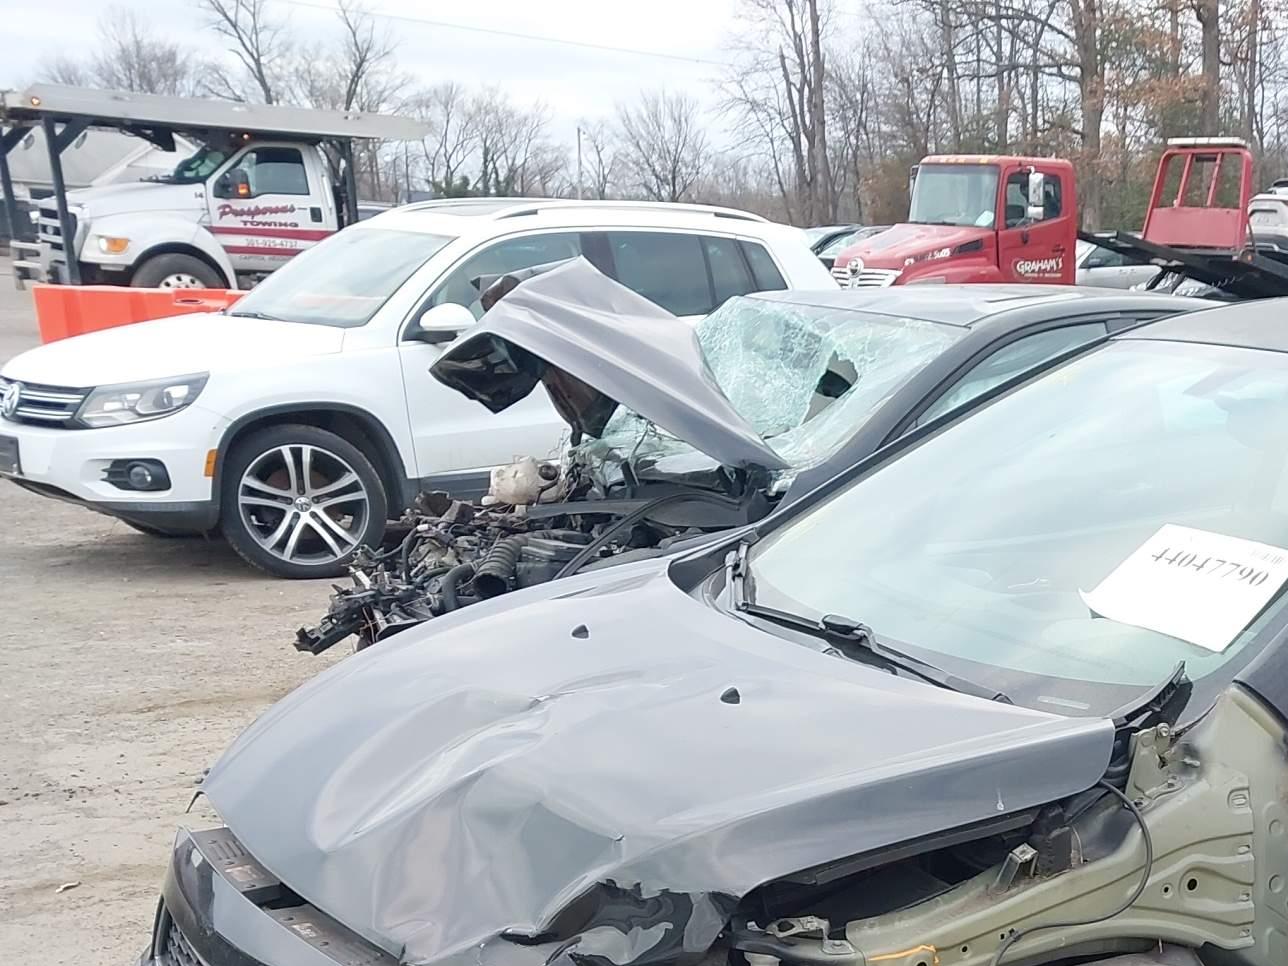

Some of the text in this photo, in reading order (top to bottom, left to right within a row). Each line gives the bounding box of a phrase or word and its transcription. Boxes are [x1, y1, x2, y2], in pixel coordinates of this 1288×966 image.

[241, 220, 299, 228] TOWING
[1016, 256, 1063, 275] GRAHAM'S
[1151, 547, 1269, 587] 44047790
